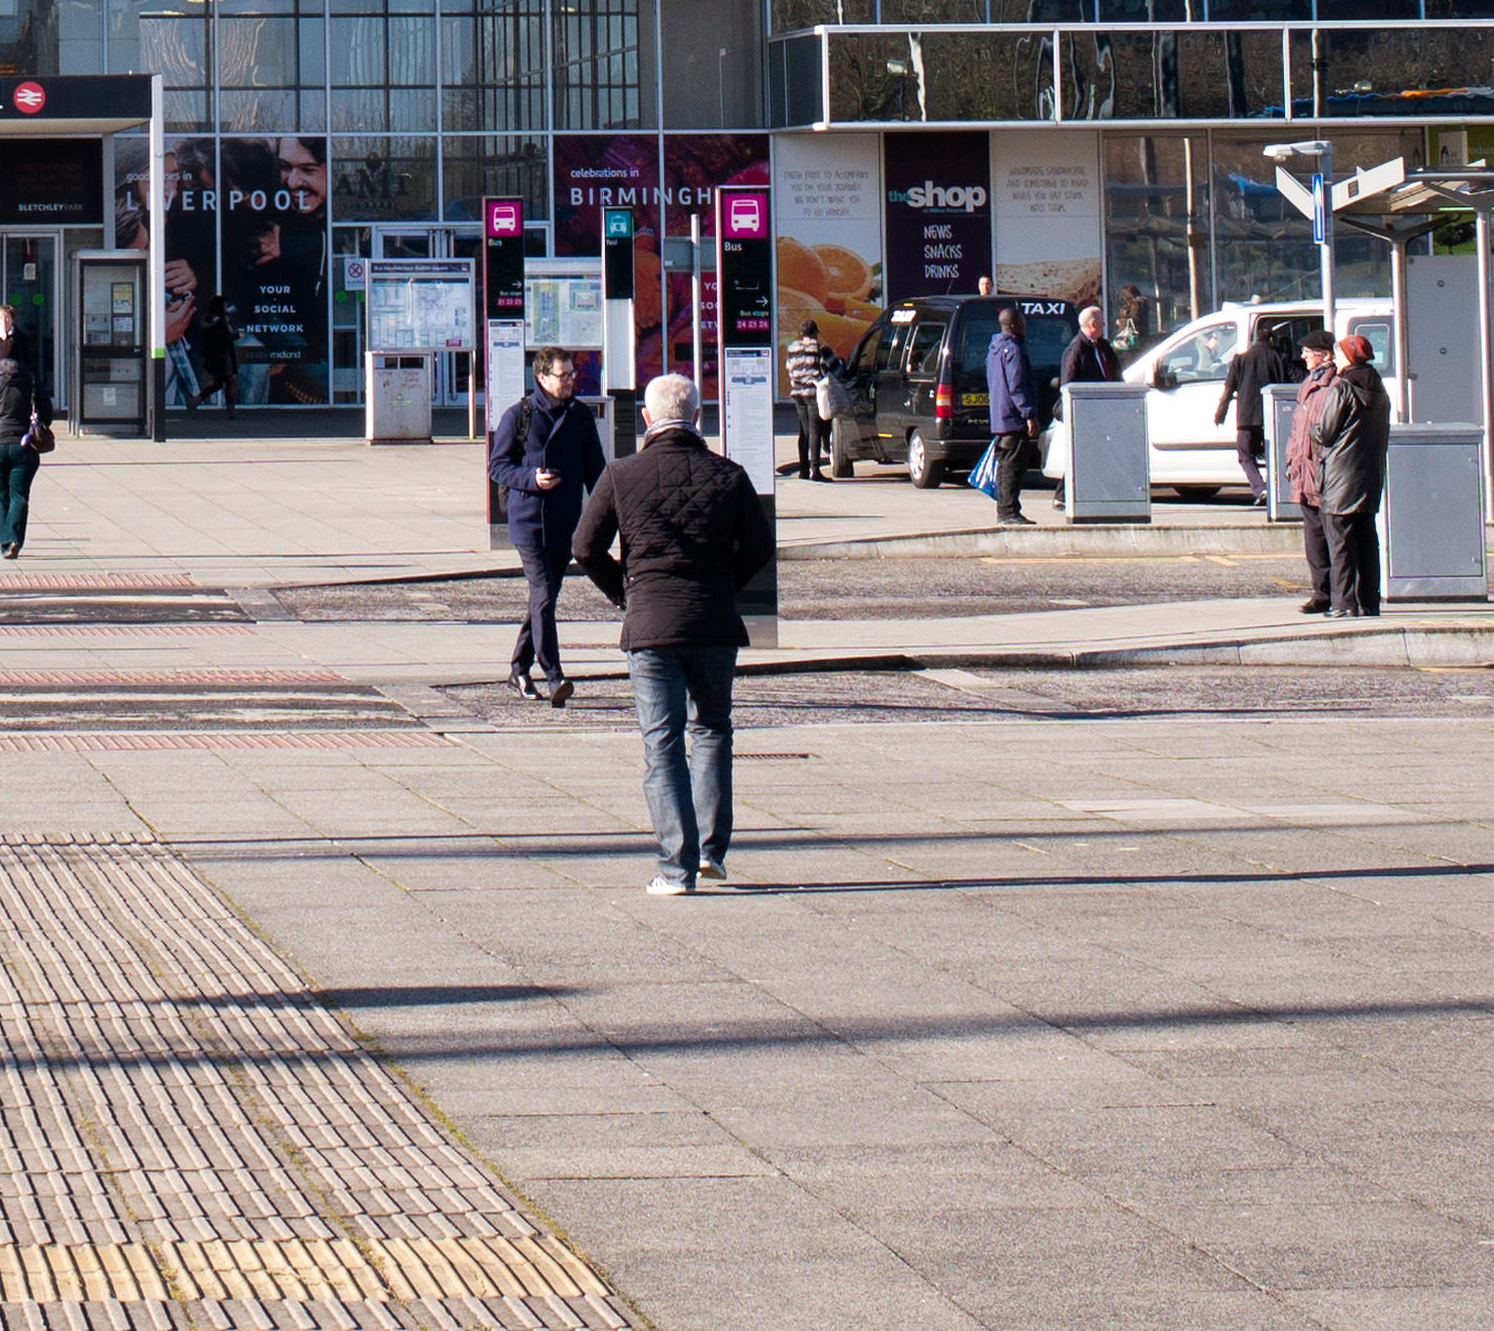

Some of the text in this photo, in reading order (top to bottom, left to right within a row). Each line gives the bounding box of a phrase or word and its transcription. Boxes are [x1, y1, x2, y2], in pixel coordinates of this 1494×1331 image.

[182, 170, 193, 181] in
[570, 167, 639, 178] celebrations in
[570, 187, 712, 206] BIRMINGH
[888, 180, 987, 213] the shop
[924, 224, 953, 239] NEWS
[724, 241, 743, 251] Bus
[924, 243, 963, 259] SNACKS
[924, 264, 960, 278] DRINKS
[259, 285, 291, 294] YOUR
[254, 304, 297, 313] SOCIAL
[1020, 302, 1066, 315] TAXI
[246, 324, 304, 333] NETWORK
